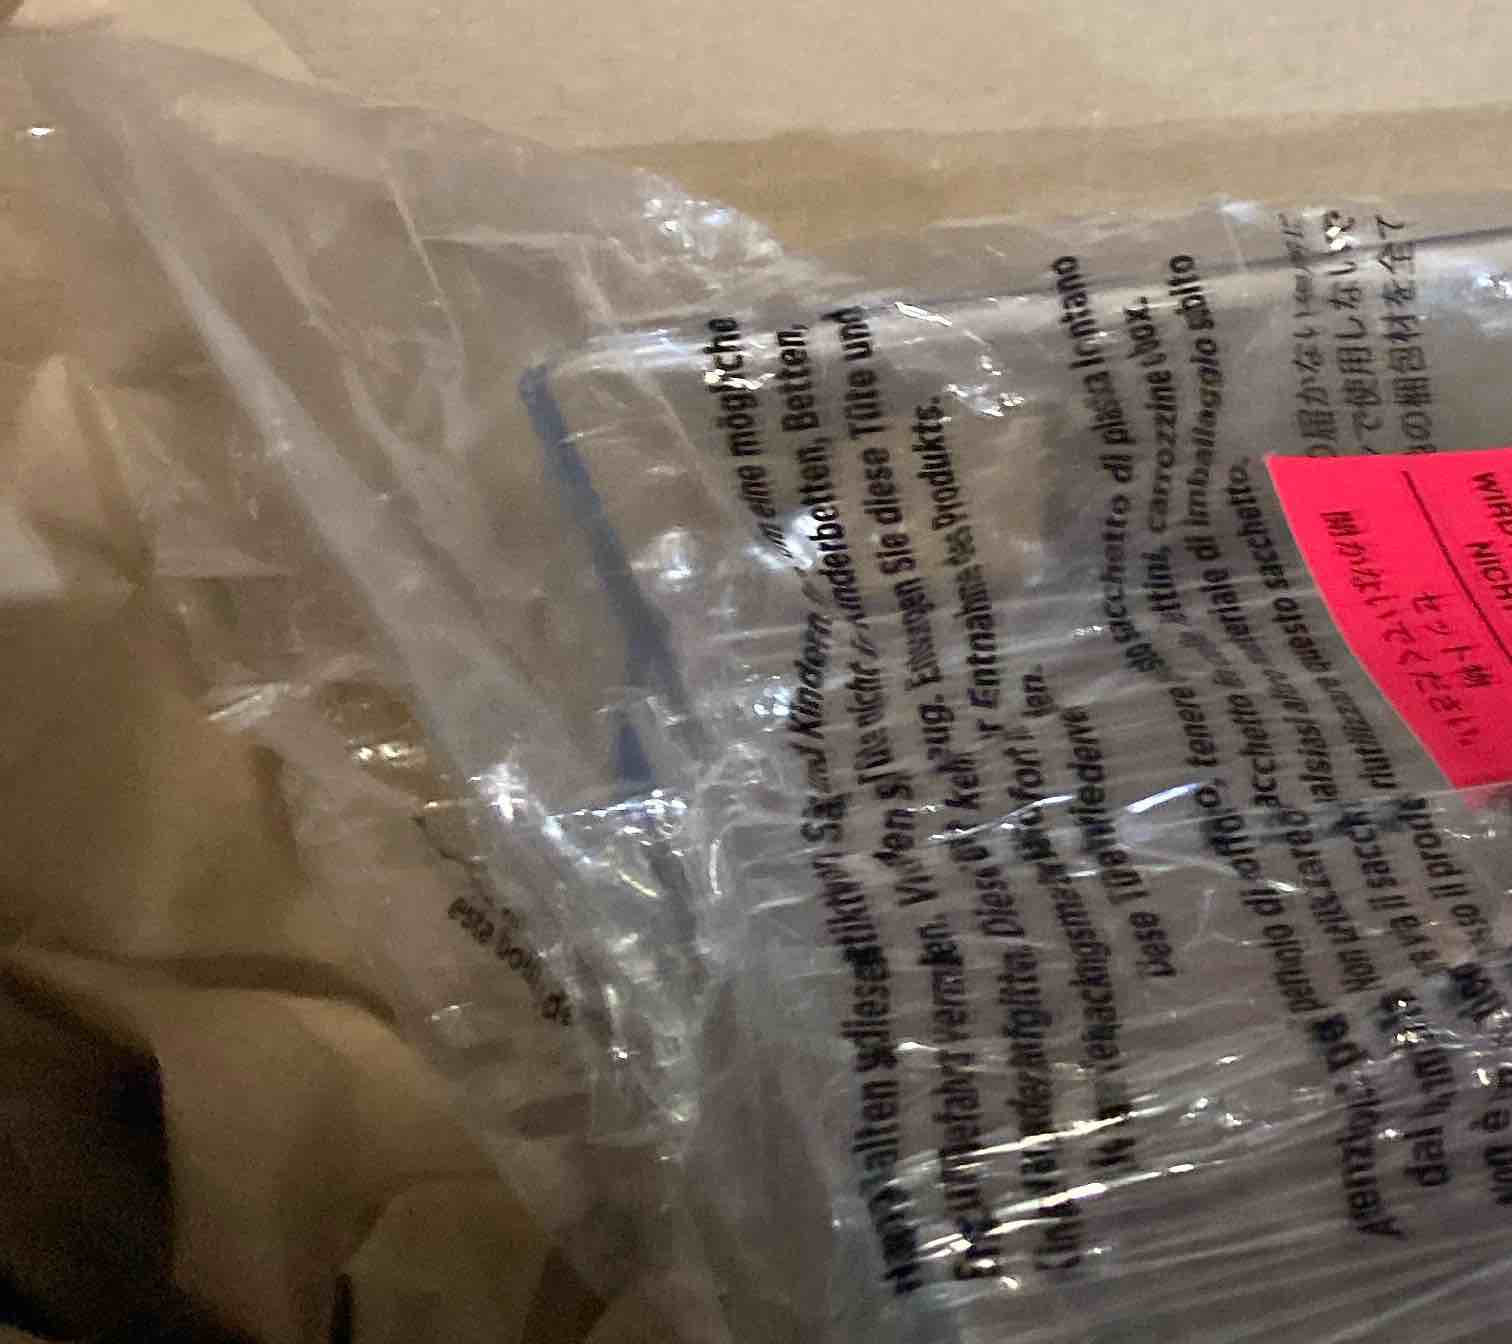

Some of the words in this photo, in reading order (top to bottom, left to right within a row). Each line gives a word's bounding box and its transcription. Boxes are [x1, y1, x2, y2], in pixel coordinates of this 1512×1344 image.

[818, 306, 872, 362] und
[774, 324, 822, 431] Betten,
[842, 367, 887, 441] Tüte
[910, 394, 968, 532] Produkts.
[1099, 452, 1136, 484] di
[1145, 368, 1180, 535] carrozzine
[1180, 336, 1226, 528] imballaggio
[859, 447, 904, 526] diese
[1226, 452, 1294, 592] sacchetto.
[873, 532, 918, 577] Sie
[1180, 535, 1222, 562] di
[1268, 593, 1334, 674] questo
[1167, 686, 1220, 770] tenere
